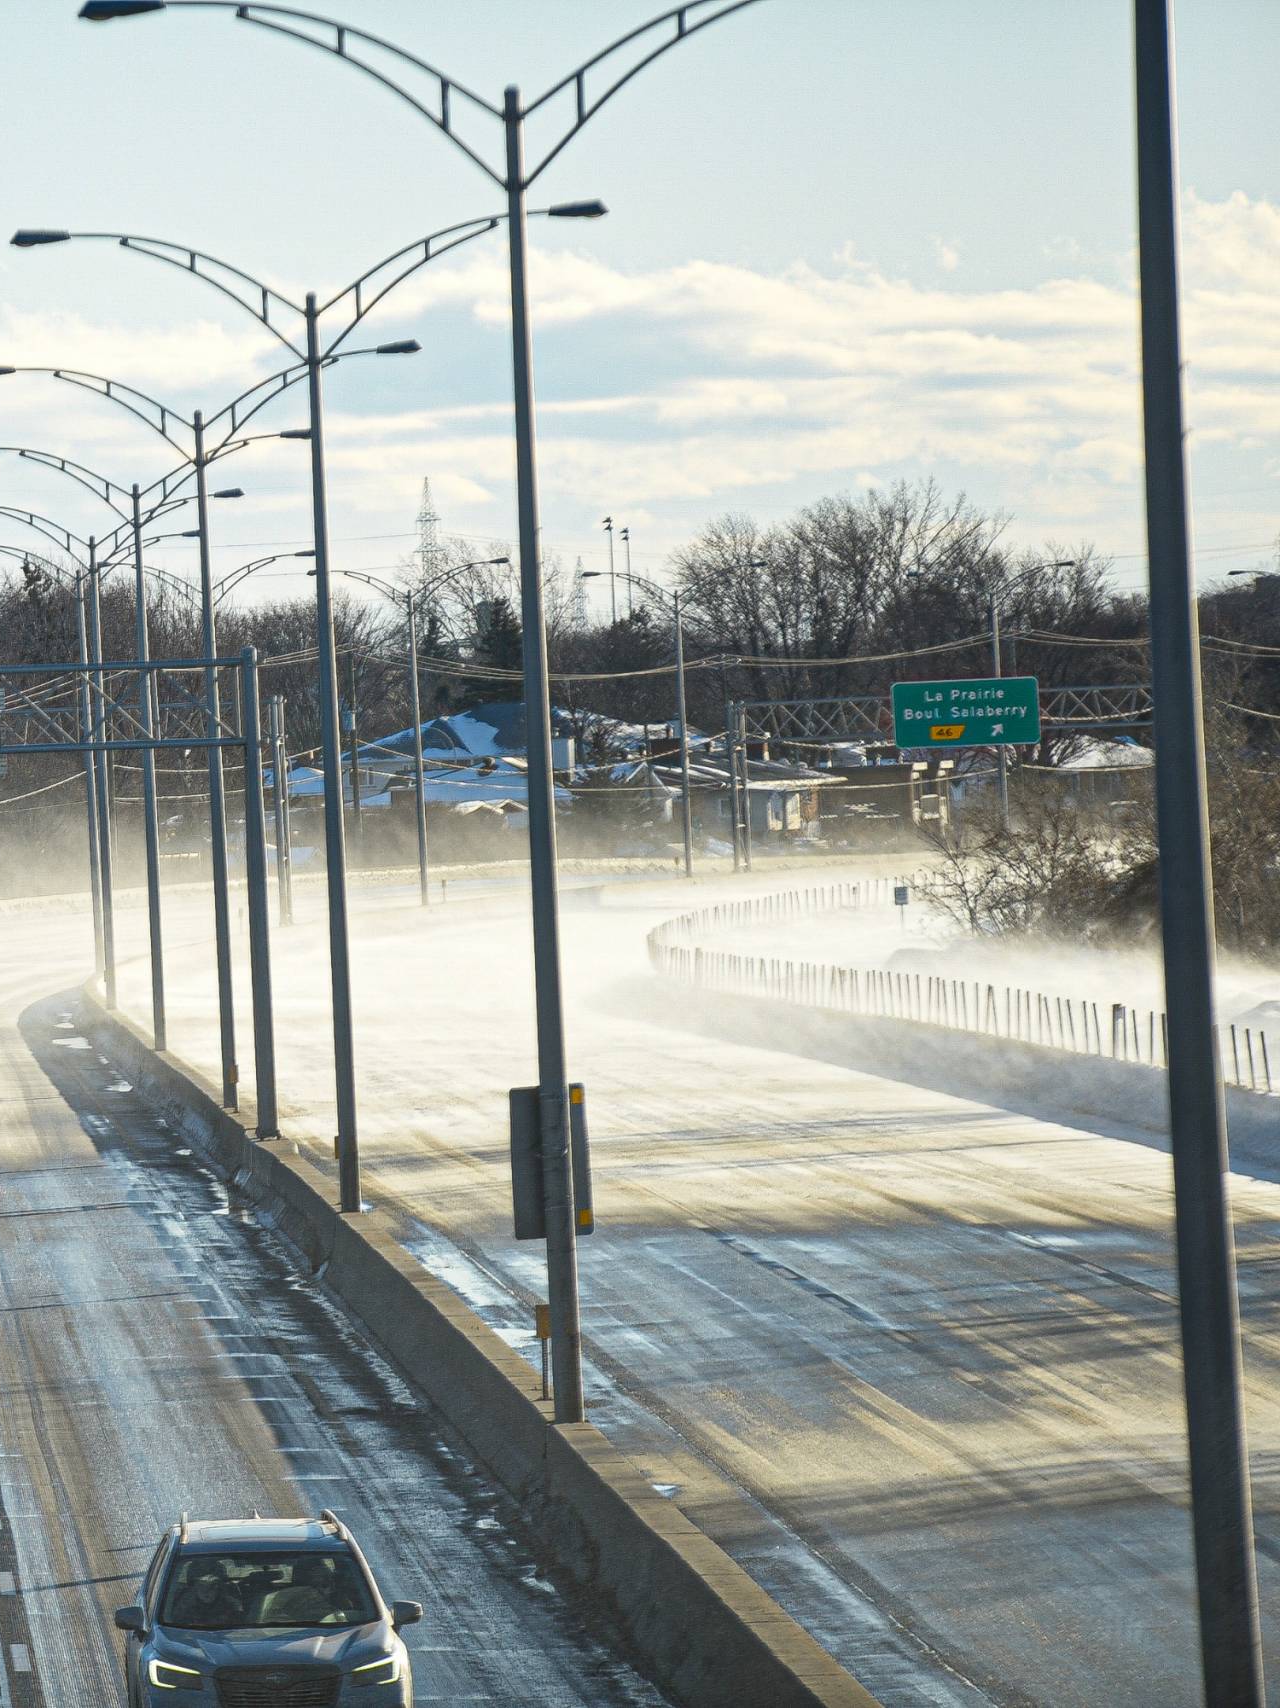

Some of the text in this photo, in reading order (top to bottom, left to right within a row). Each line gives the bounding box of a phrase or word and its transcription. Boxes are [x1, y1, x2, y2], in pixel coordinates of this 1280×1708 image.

[925, 688, 1005, 702] La Prairie
[951, 705, 1028, 718] Salaberry
[935, 727, 953, 736] 46
